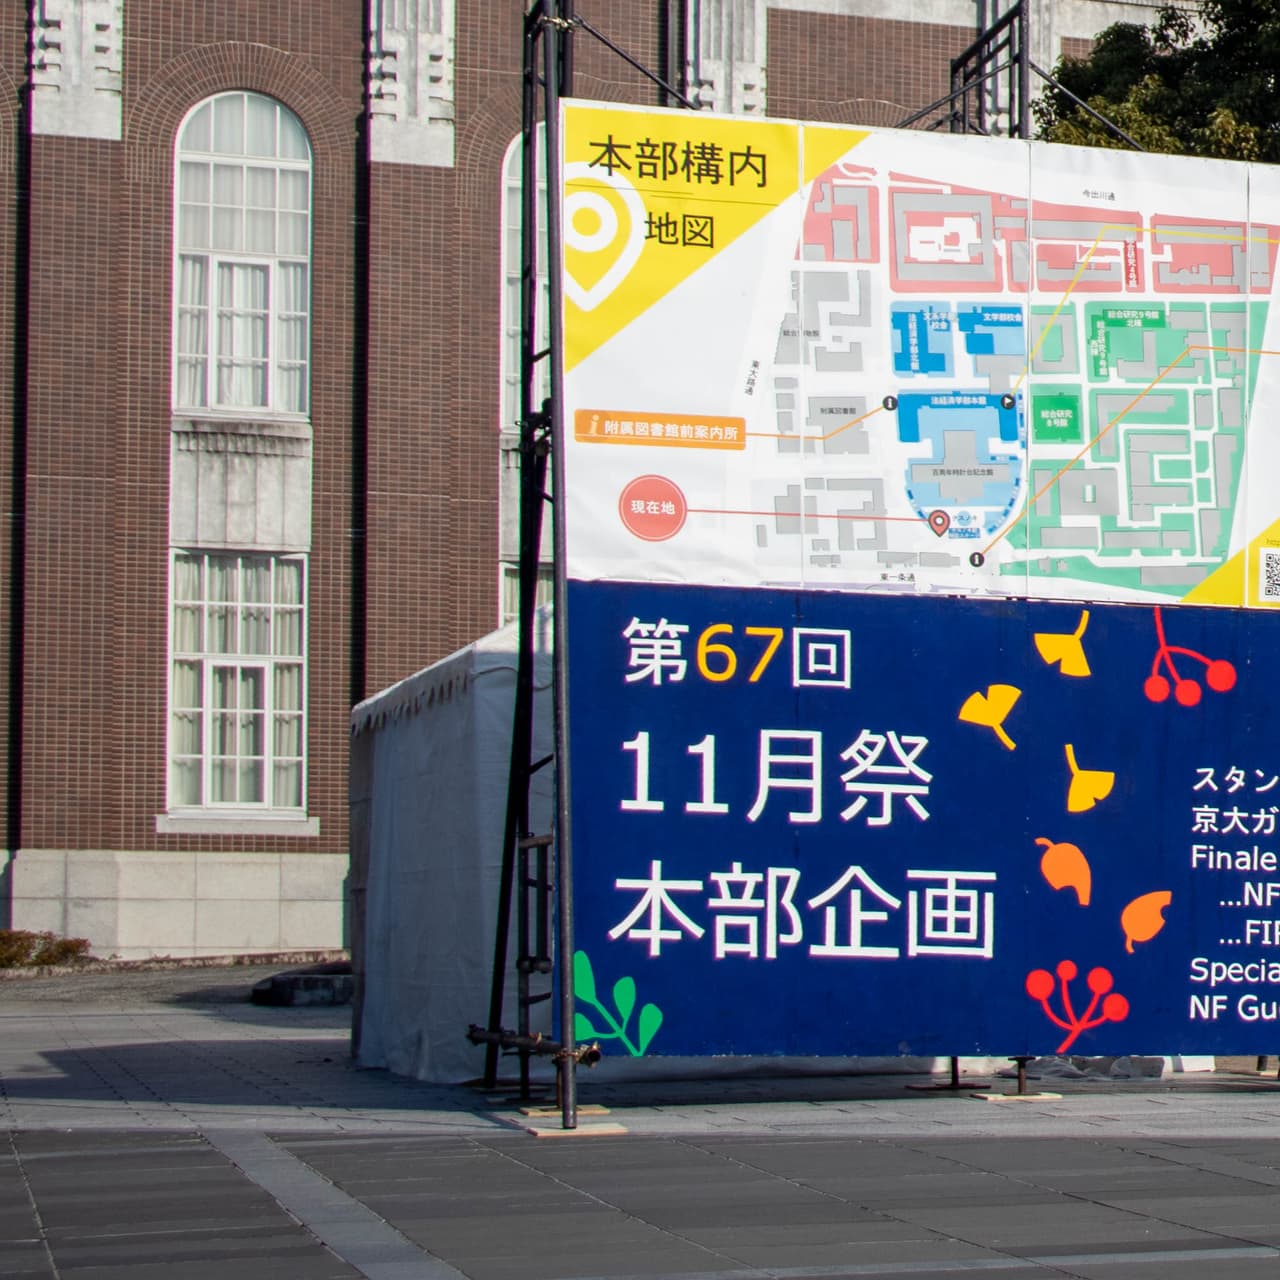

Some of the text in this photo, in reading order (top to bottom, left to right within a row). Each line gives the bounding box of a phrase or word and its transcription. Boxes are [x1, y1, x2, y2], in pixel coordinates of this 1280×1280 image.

[588, 134, 767, 188] 本部構内
[644, 212, 714, 248] 地図
[604, 419, 739, 441] 附属図書館前案内所
[631, 499, 677, 516] 現在地
[622, 616, 852, 689] 第67回
[620, 728, 934, 826] 11月祭
[1191, 844, 1278, 871] Finale
[608, 859, 998, 959] 本部企画
[1189, 994, 1228, 1020] NF
